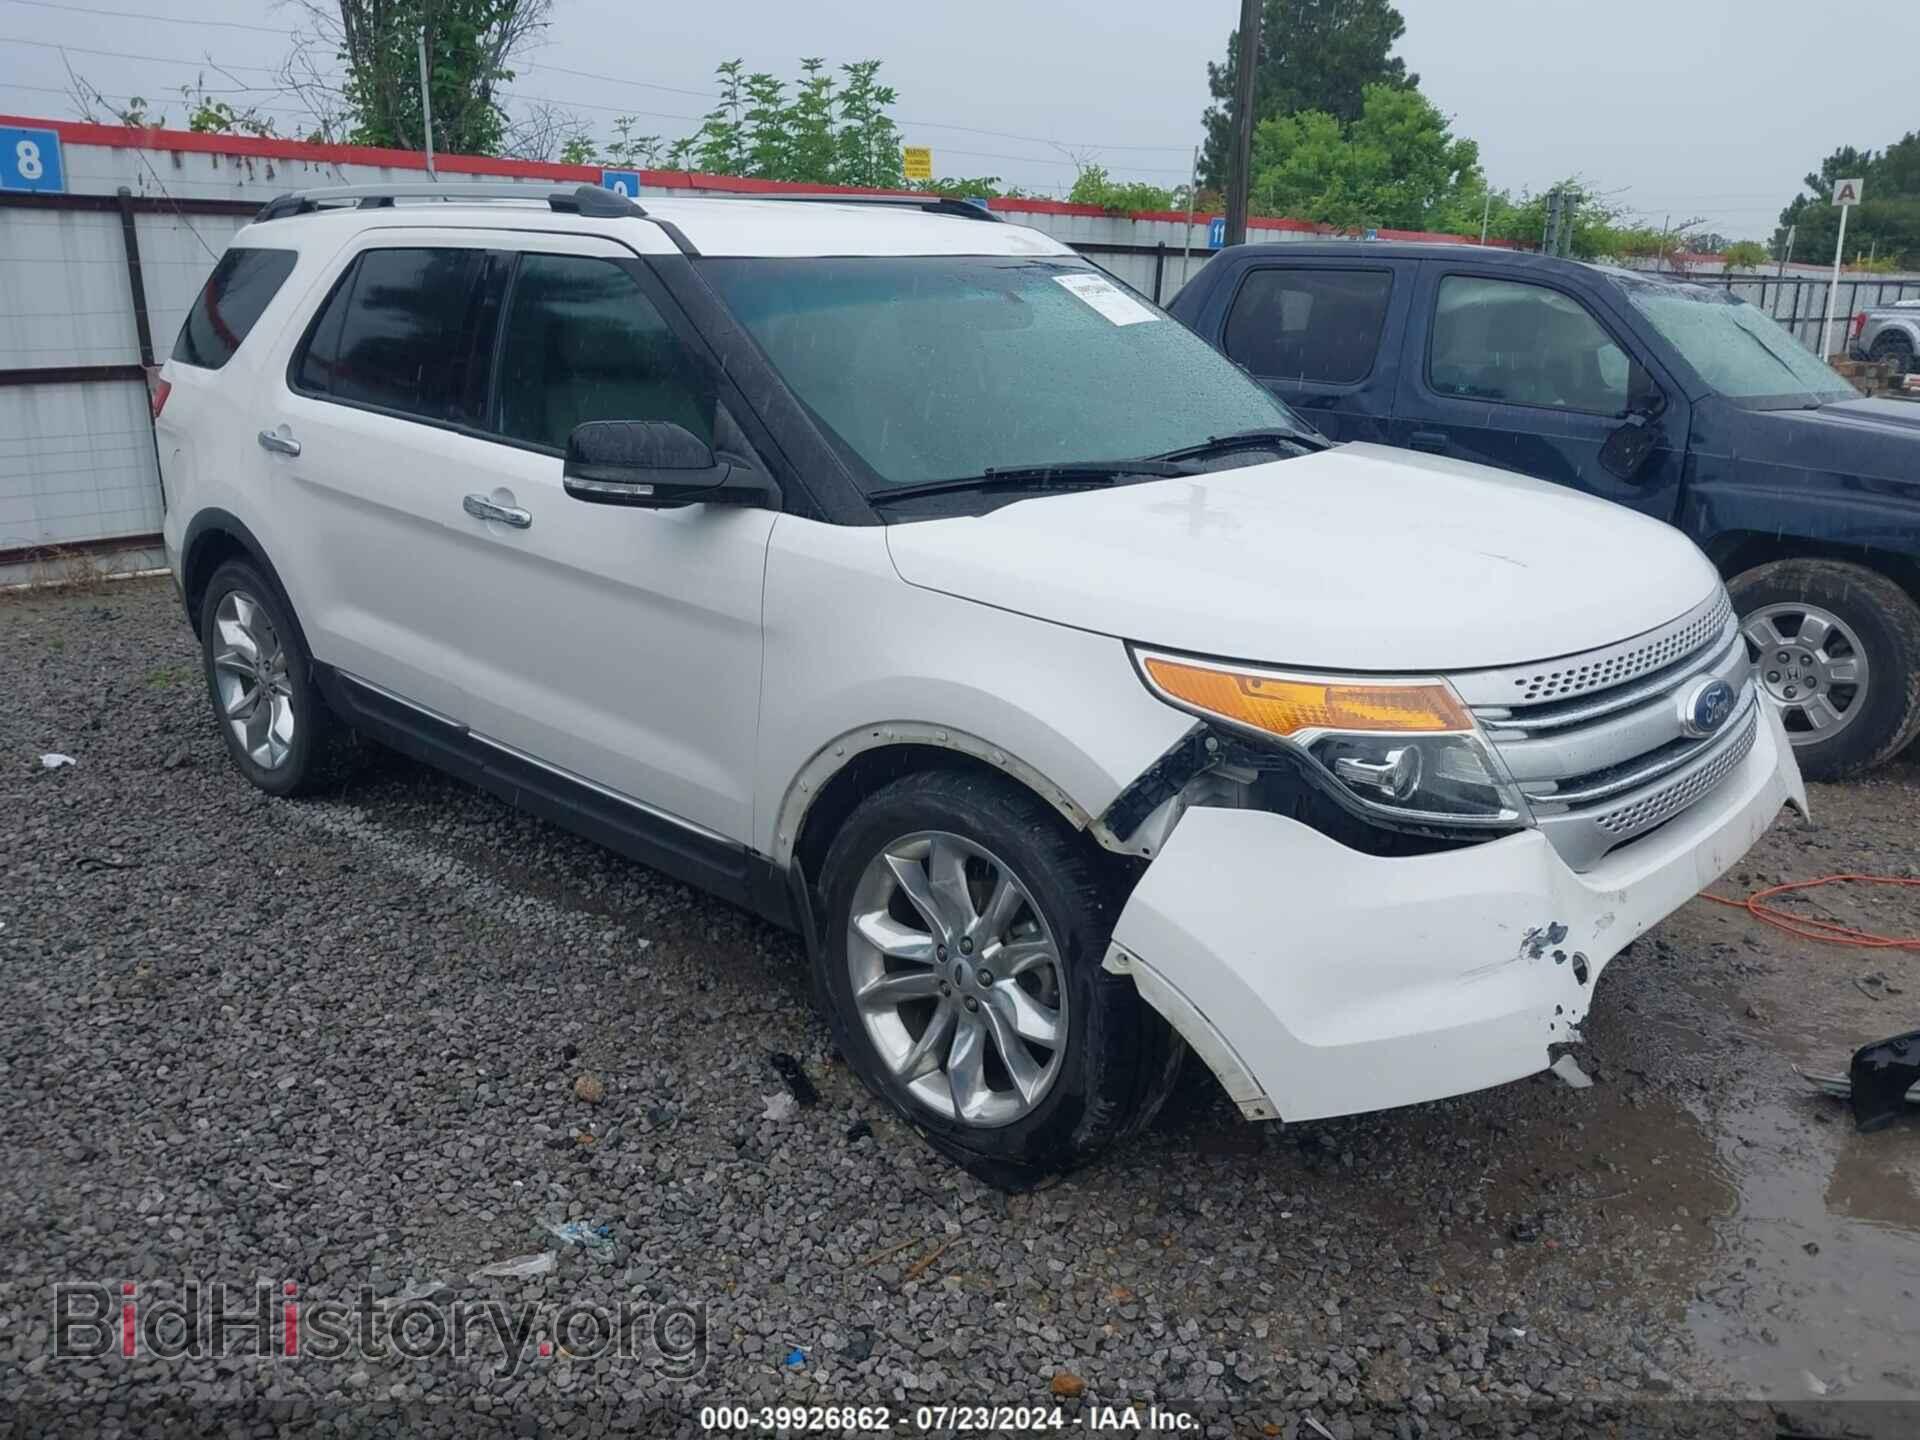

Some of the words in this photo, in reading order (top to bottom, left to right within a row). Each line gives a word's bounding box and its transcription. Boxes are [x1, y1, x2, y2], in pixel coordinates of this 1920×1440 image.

[16, 140, 43, 180] 8
[1837, 183, 1856, 201] A
[1214, 223, 1225, 244] 11
[1705, 686, 1730, 724] Ford
